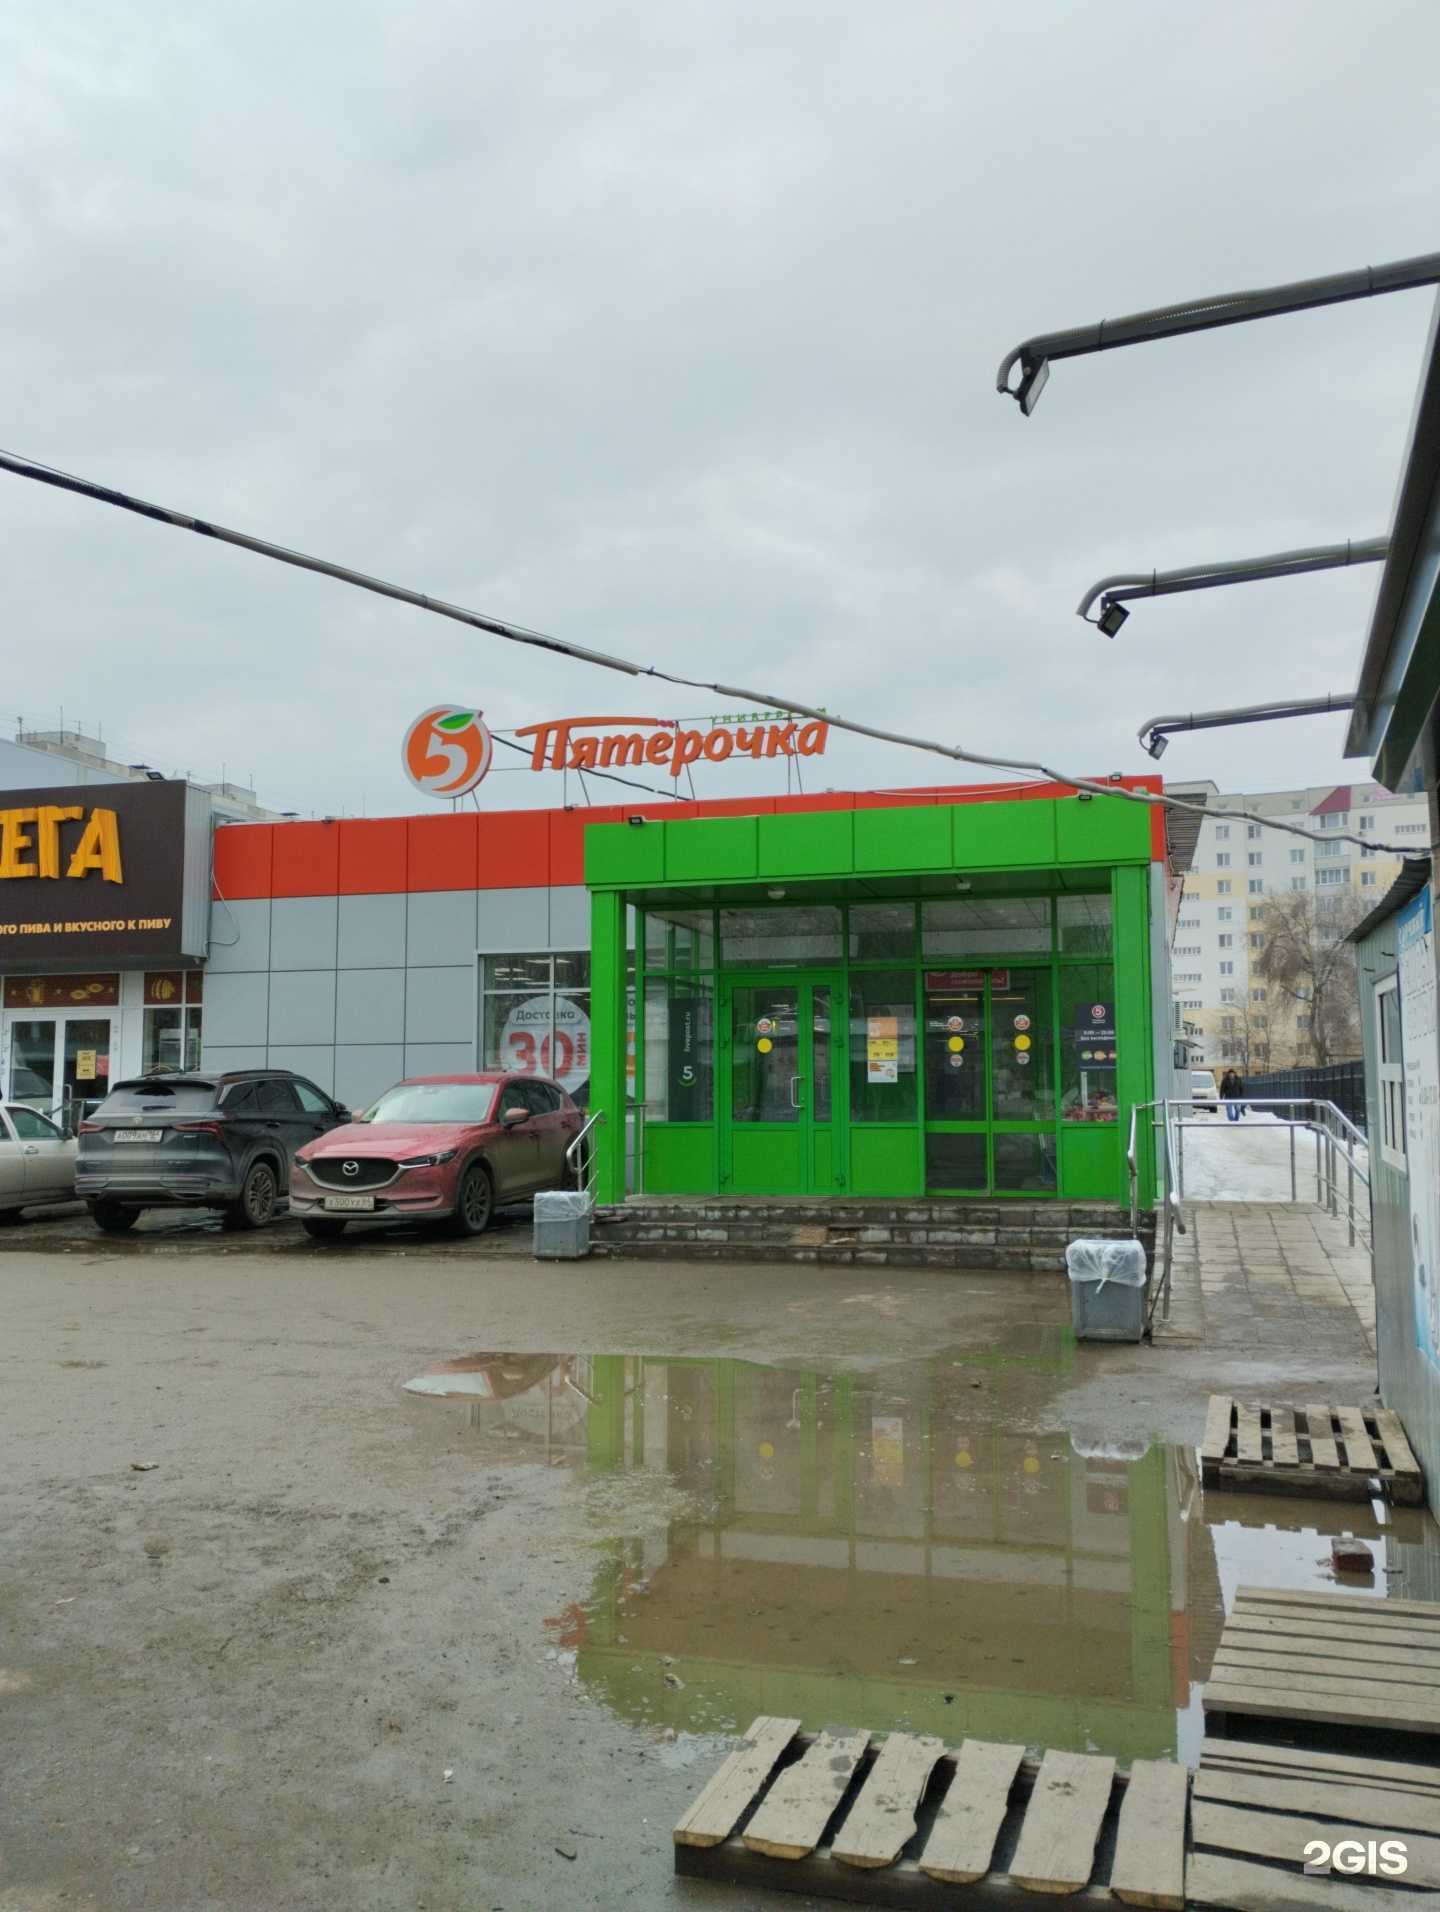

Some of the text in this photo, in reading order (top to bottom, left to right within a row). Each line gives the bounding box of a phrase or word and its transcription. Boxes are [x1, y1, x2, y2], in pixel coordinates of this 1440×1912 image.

[710, 706, 827, 726] УНИВЕРСМ
[515, 716, 830, 776] Пятерочка
[19, 923, 51, 934] ПИВА
[53, 923, 62, 933] И
[64, 920, 125, 932] ВКУСНОГО
[127, 919, 136, 930] К
[138, 918, 172, 929] ПИВУ
[515, 1010, 576, 1021] Достка
[508, 1030, 574, 1080] 30
[682, 1065, 694, 1080] 5
